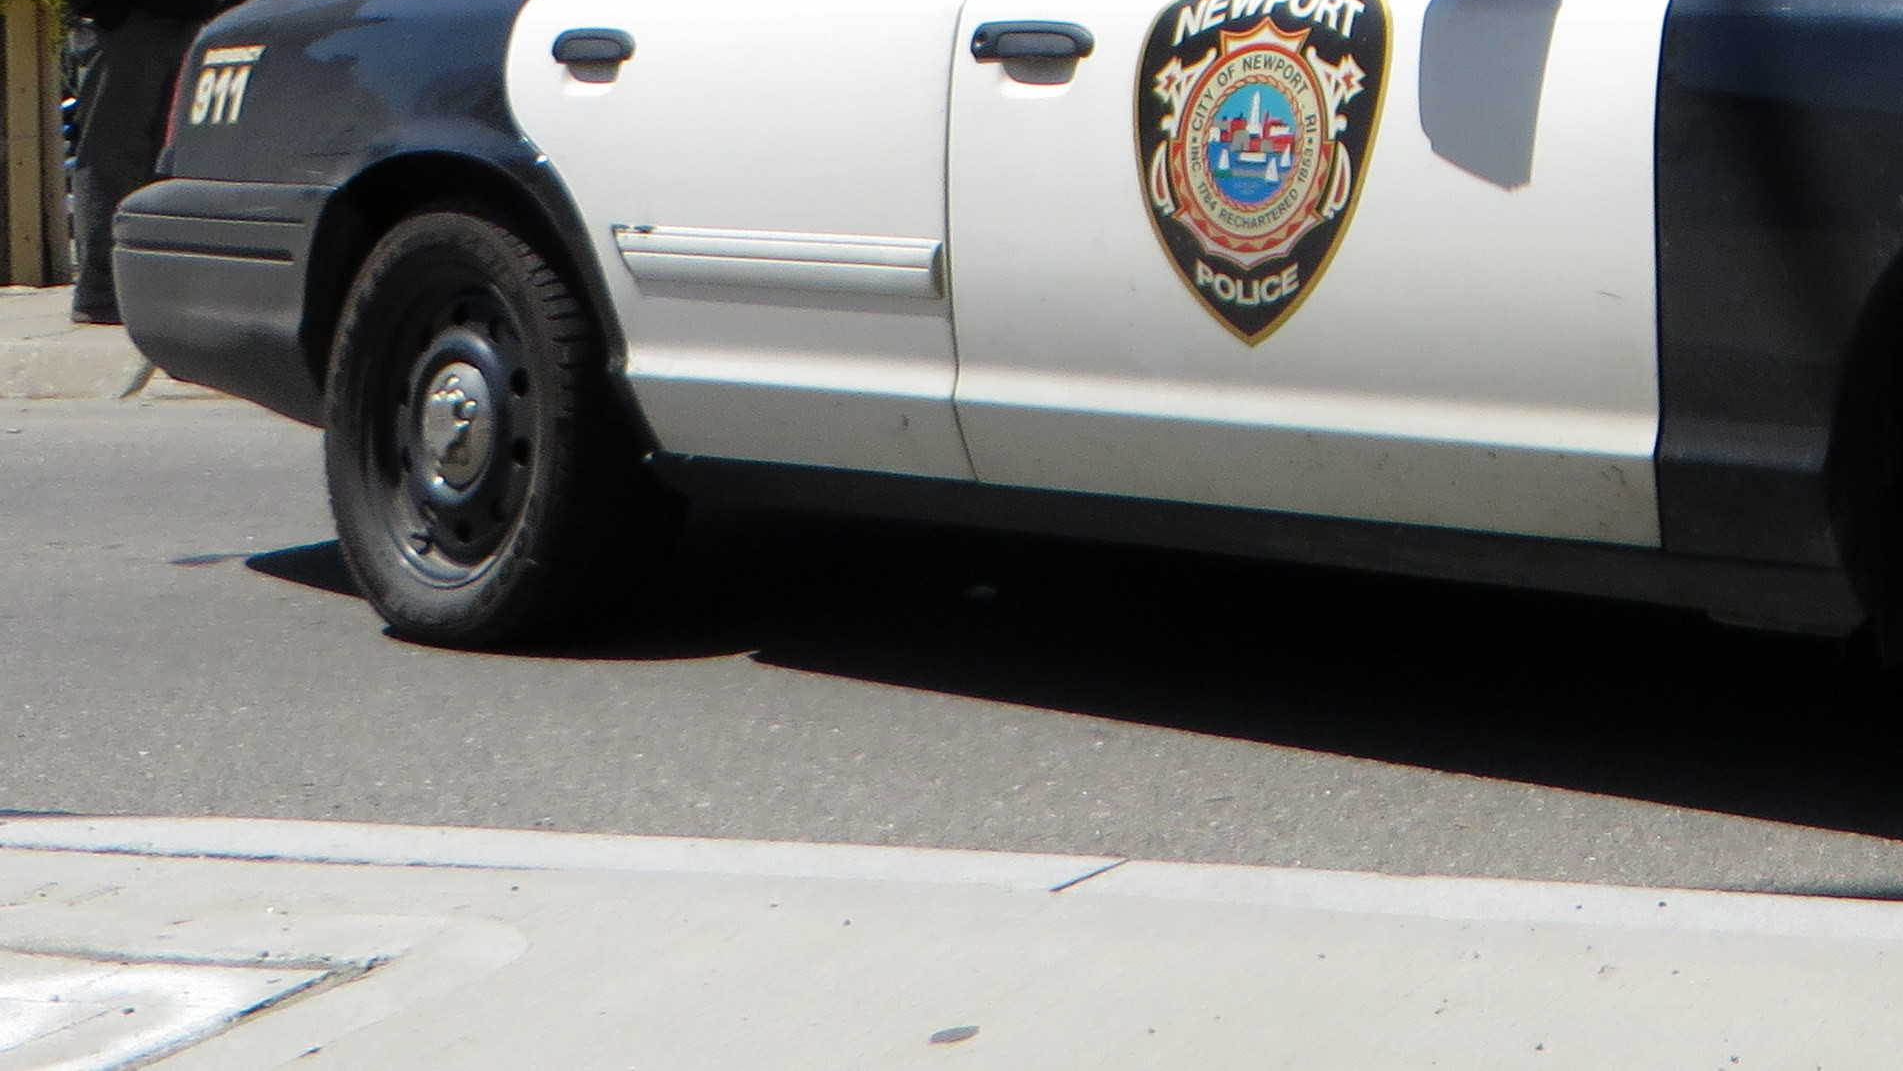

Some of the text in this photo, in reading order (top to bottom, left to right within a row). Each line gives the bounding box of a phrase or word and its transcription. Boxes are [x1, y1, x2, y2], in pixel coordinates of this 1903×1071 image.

[189, 66, 251, 125] 911
[1192, 54, 1317, 133] CITY OF NEWPORT RI
[1198, 181, 1217, 210] 1784
[1219, 188, 1298, 228] RECHARTERED
[1196, 259, 1299, 306] POLICE
